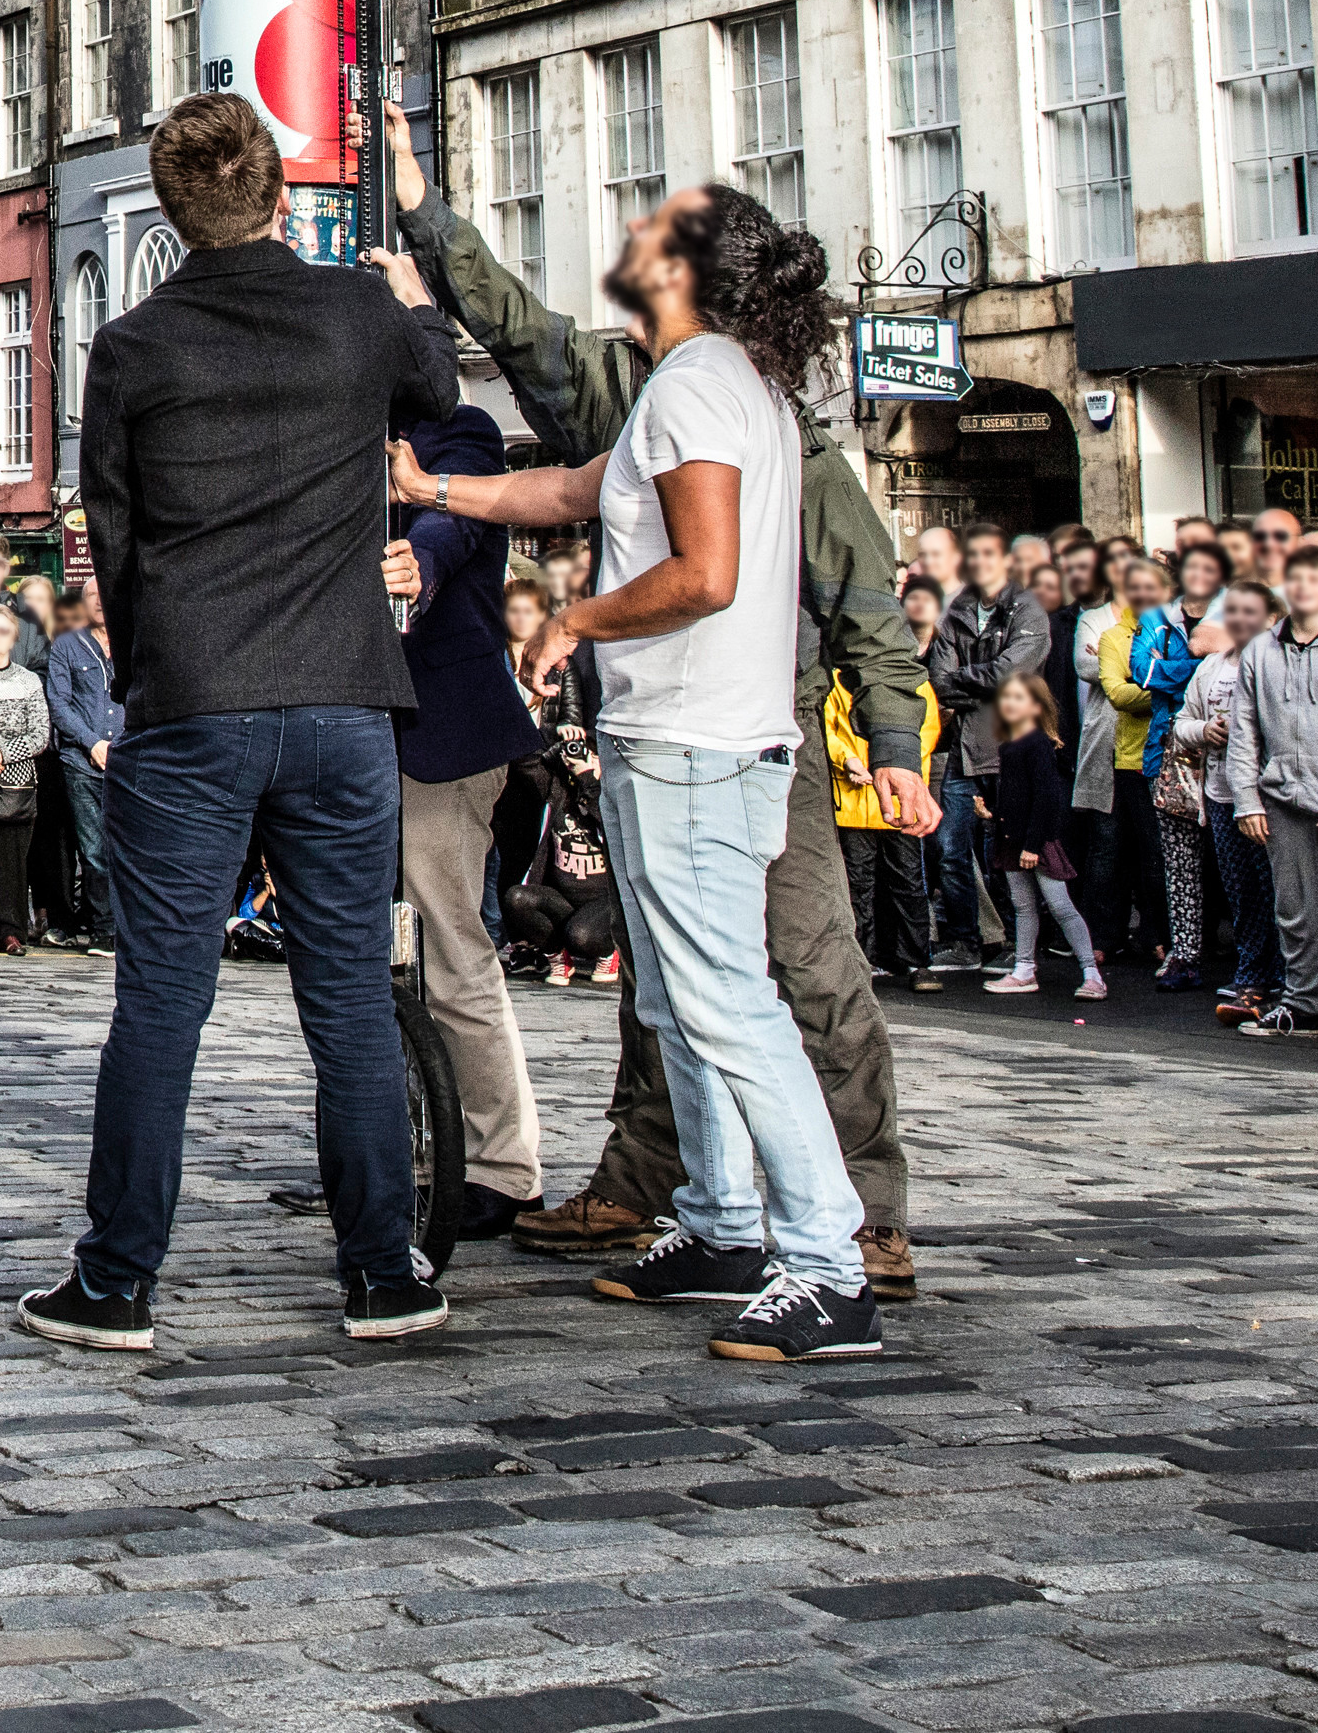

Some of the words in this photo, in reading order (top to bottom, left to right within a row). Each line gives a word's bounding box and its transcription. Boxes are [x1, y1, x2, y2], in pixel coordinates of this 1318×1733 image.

[875, 319, 935, 352] fringe
[866, 355, 912, 381] Ticket
[914, 365, 957, 390] Sales
[1087, 395, 1107, 403] IMMS
[962, 418, 978, 429] OLD
[981, 416, 1018, 428] ASSEMBLY
[1022, 416, 1047, 427] CLOSE
